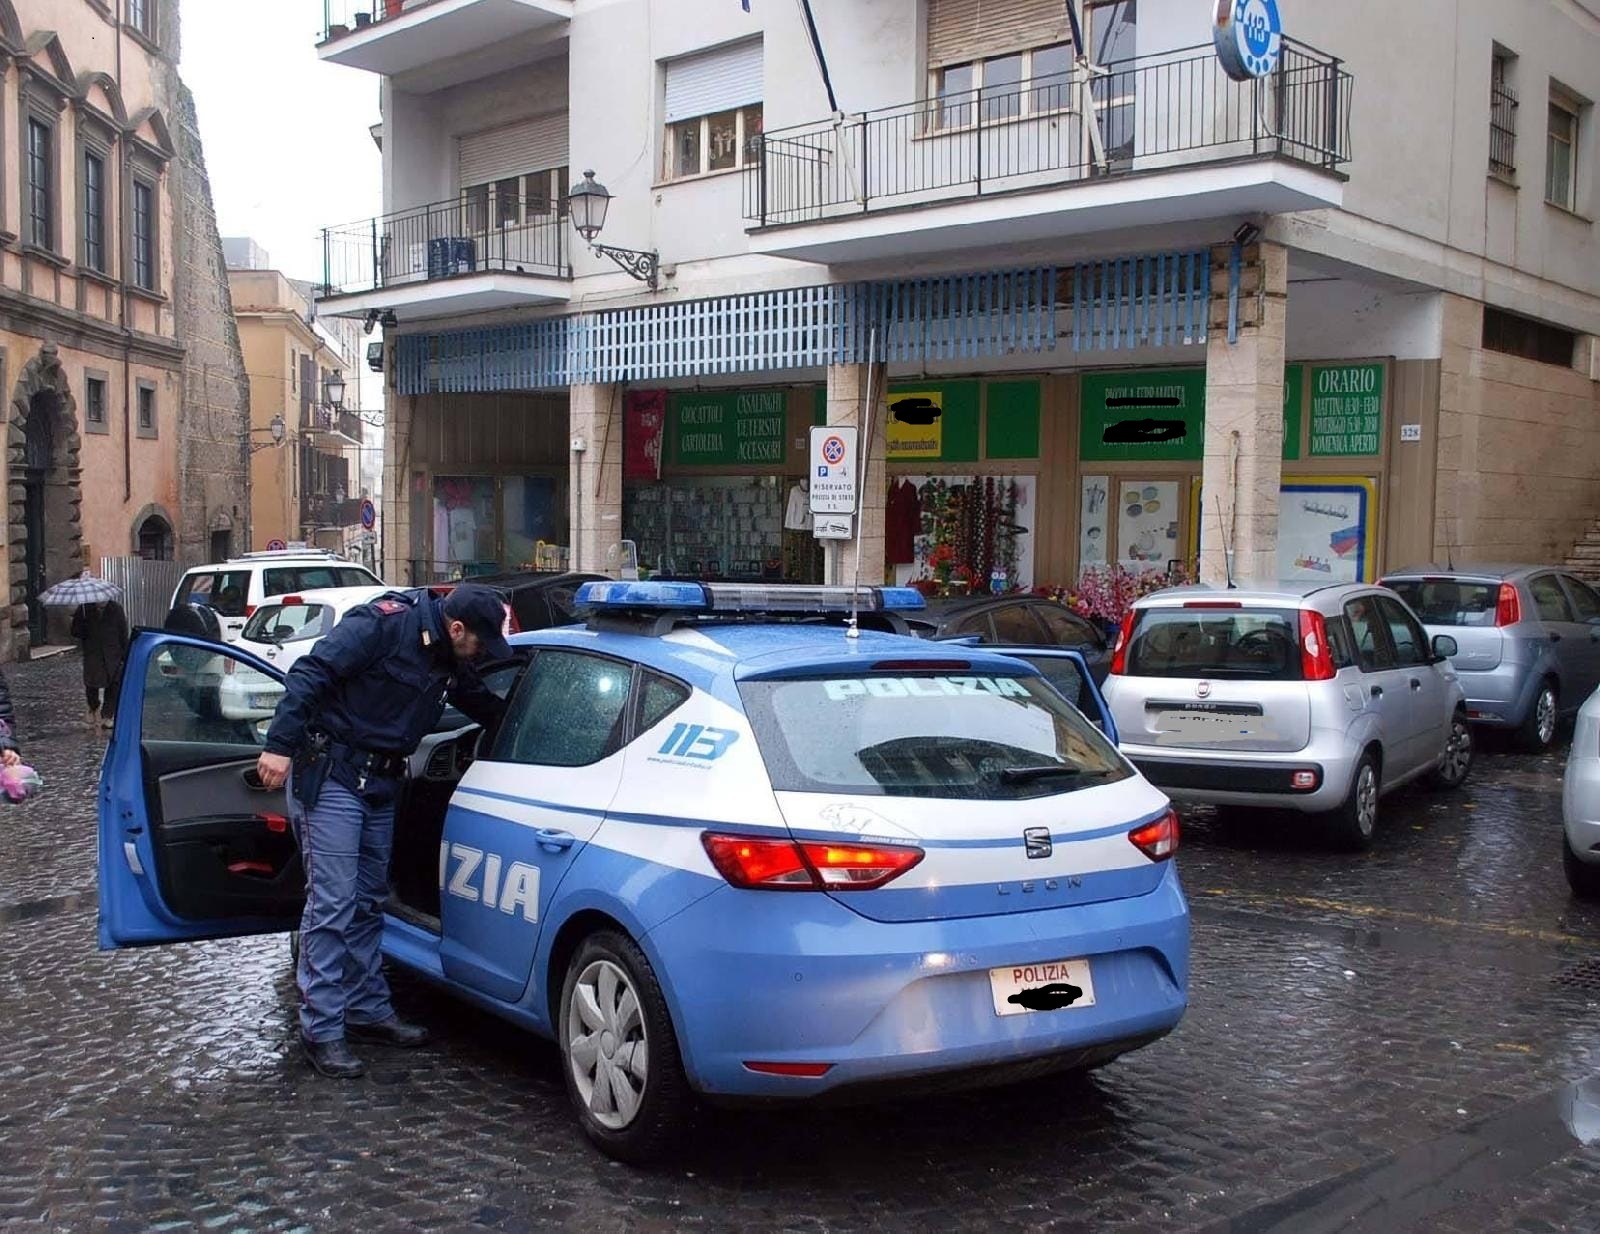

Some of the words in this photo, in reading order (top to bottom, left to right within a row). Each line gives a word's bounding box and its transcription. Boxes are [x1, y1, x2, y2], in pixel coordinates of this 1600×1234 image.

[1247, 12, 1266, 42] 113
[1319, 367, 1375, 393] ORARIO
[737, 392, 782, 414] CASALINGHI
[737, 417, 781, 437] DETERSIVI
[681, 432, 724, 452] CARTOLERIA
[737, 440, 781, 460] ACCESSORI
[1348, 434, 1377, 452] APERTO
[814, 484, 852, 492] RISERVATO
[823, 677, 1032, 700] POLIZIA
[657, 722, 740, 761] 113
[997, 876, 1081, 896] LEON
[1012, 964, 1070, 985] POLIZIA
